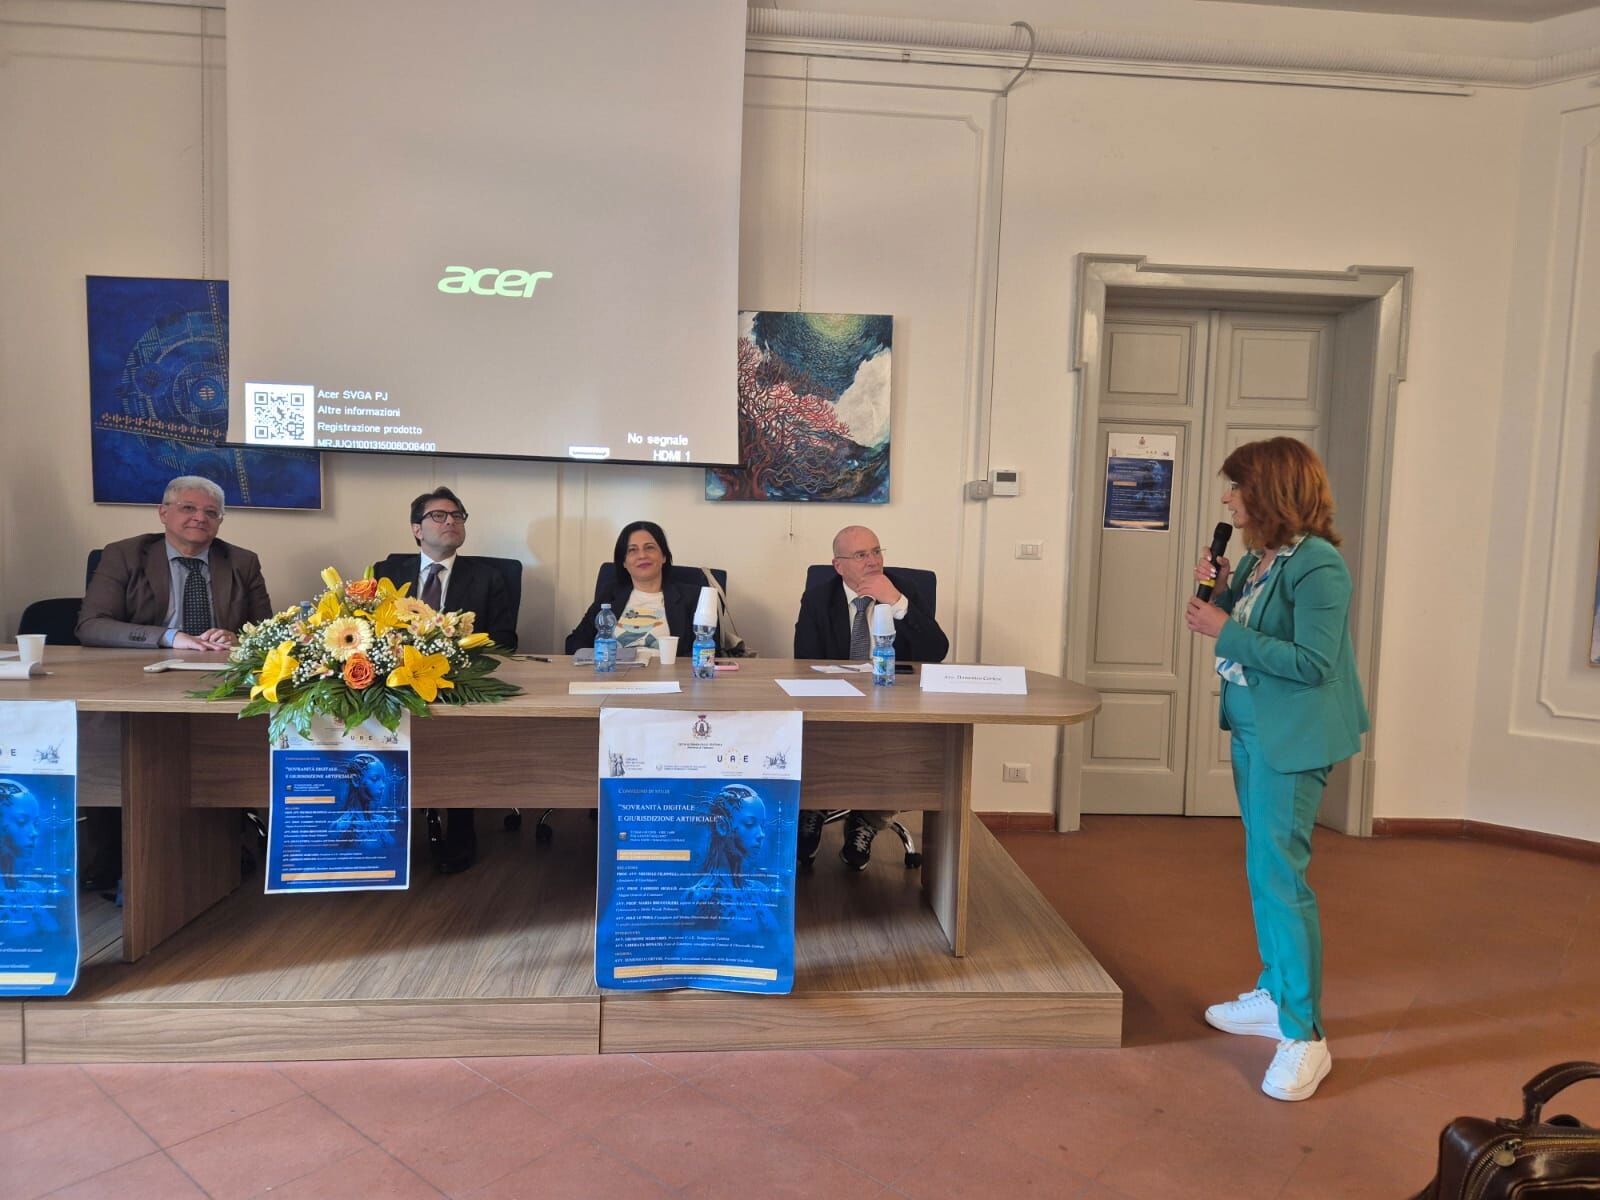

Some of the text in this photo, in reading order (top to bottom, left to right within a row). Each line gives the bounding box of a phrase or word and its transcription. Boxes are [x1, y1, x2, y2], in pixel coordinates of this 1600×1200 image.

[437, 265, 553, 298] acer
[317, 389, 389, 401] Acer SVGA PJ
[317, 405, 401, 417] Altre informazioni
[317, 421, 423, 435] Registrazione prodotto
[627, 432, 689, 447] No segnale
[653, 449, 691, 463] HDMI 1
